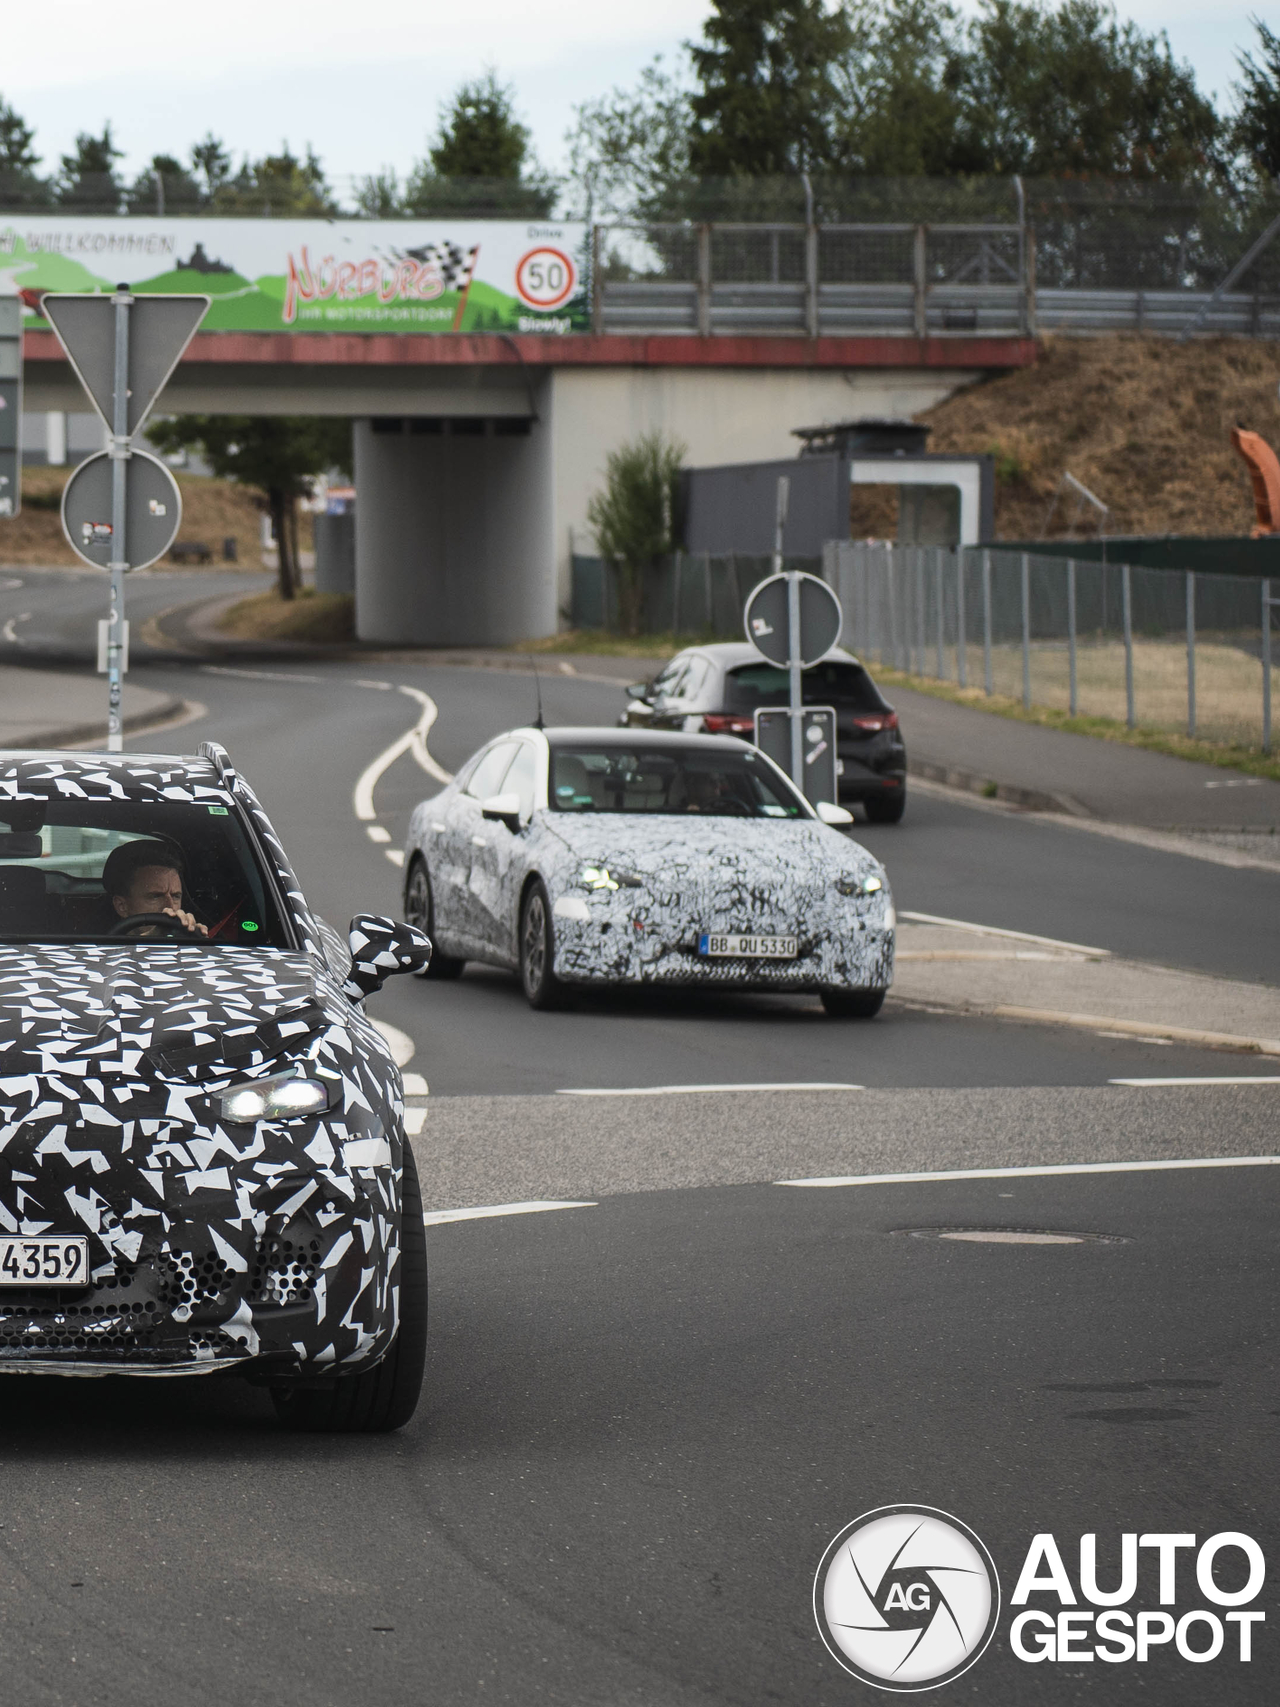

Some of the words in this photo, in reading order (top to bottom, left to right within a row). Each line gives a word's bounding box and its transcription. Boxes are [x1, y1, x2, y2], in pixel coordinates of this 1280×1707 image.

[25, 231, 176, 253] WILLKOMMEN
[527, 226, 562, 238] Drive
[284, 245, 444, 321] NÜRBURG
[528, 263, 563, 290] 50
[299, 307, 321, 320] IHR
[324, 307, 453, 320] MOTORSPORTDORF
[519, 316, 572, 334] Slowly!
[710, 937, 729, 952] BB
[739, 938, 757, 953] QU
[761, 939, 796, 954] 5330
[2, 1244, 82, 1279] 4359
